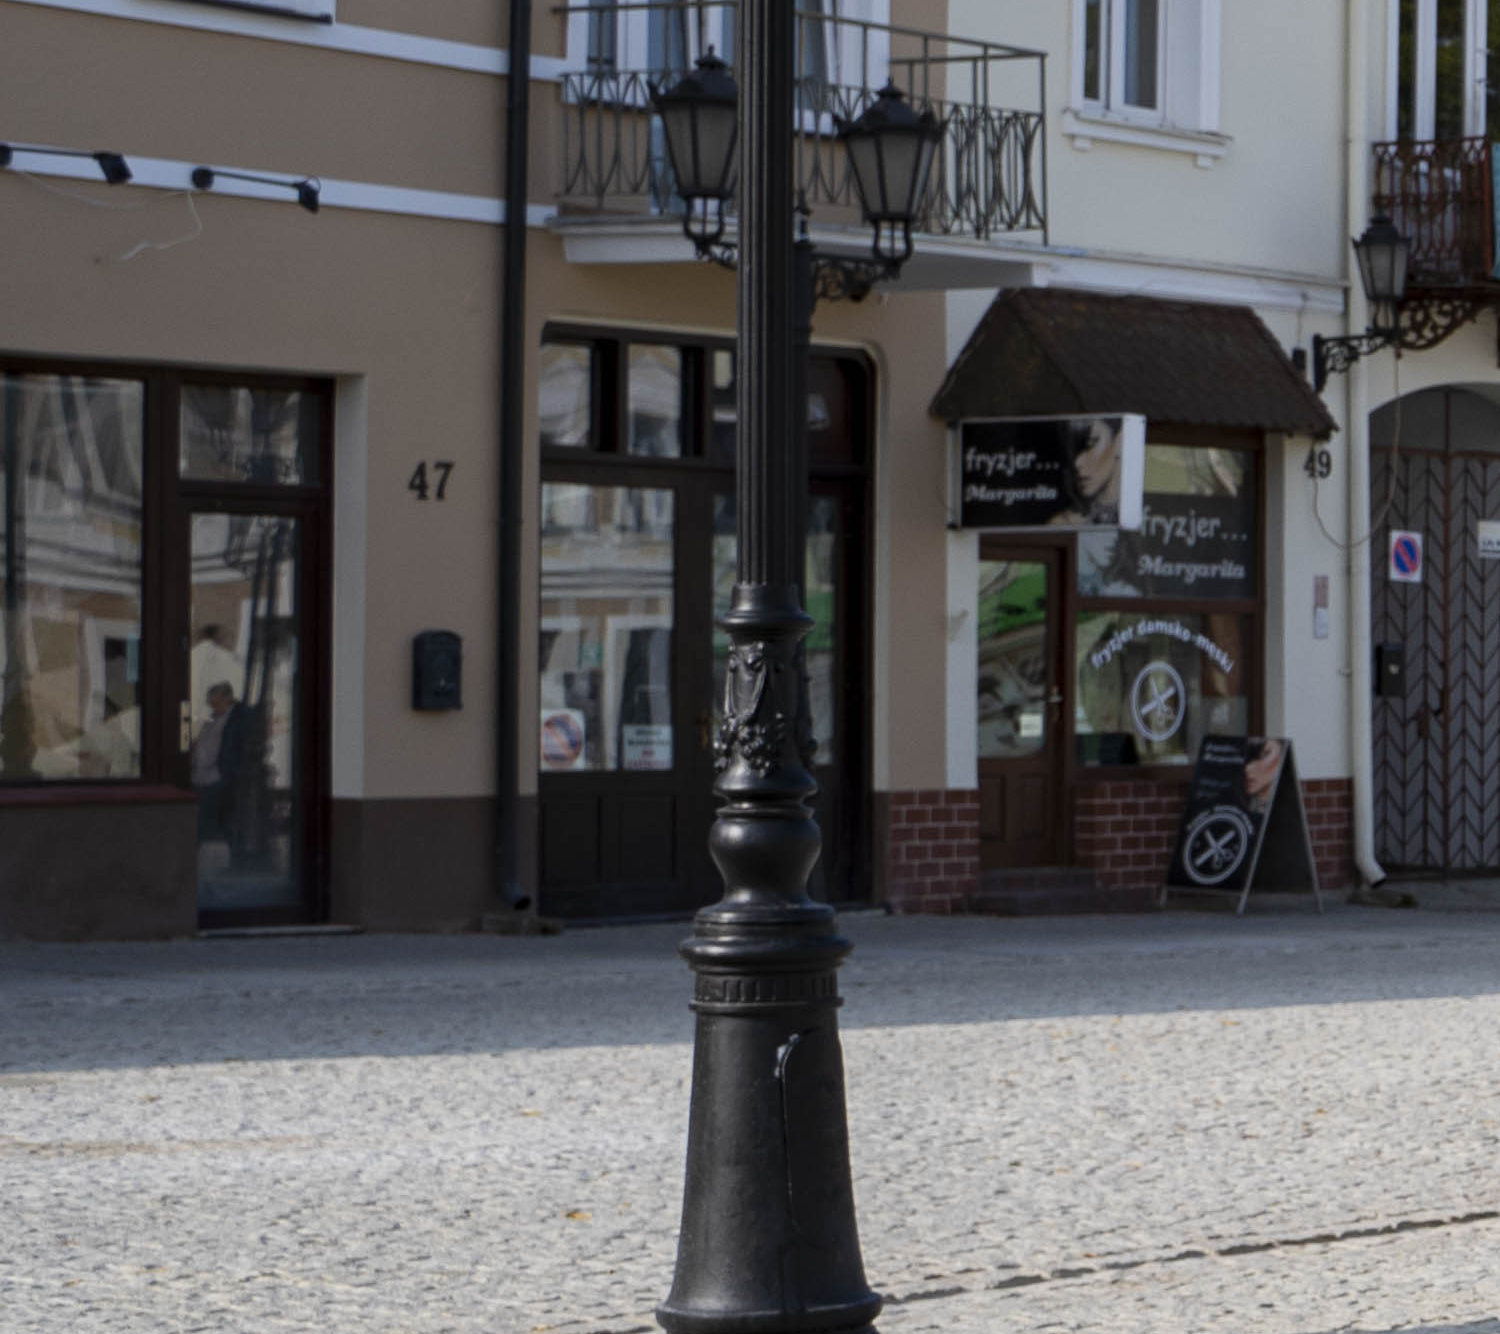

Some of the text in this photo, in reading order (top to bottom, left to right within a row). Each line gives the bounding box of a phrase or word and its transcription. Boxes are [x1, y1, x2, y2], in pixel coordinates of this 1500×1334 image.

[1303, 450, 1332, 479] 49
[408, 460, 456, 501] 47
[965, 485, 1058, 506] Margarita
[1137, 554, 1246, 584] Margarita
[1091, 626, 1135, 668] fryzjer
